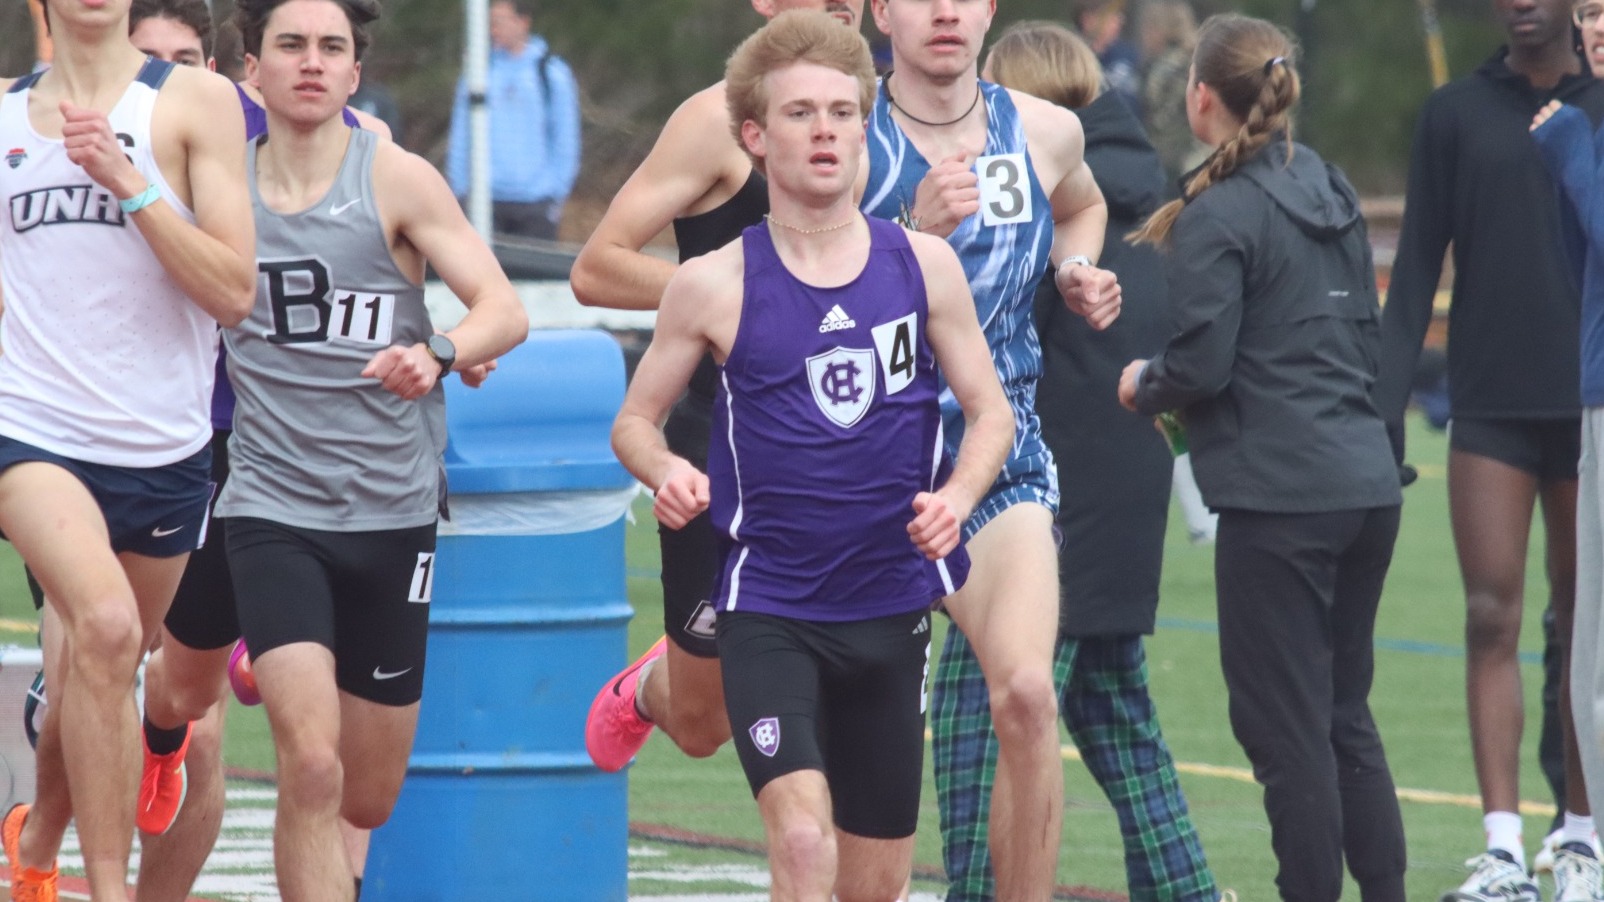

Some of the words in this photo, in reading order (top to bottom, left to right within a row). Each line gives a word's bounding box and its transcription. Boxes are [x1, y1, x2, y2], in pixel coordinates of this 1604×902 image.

[986, 158, 1025, 219] 3
[257, 256, 334, 345] B
[338, 293, 382, 341] 11
[819, 319, 856, 333] adidas
[889, 320, 914, 381] 4
